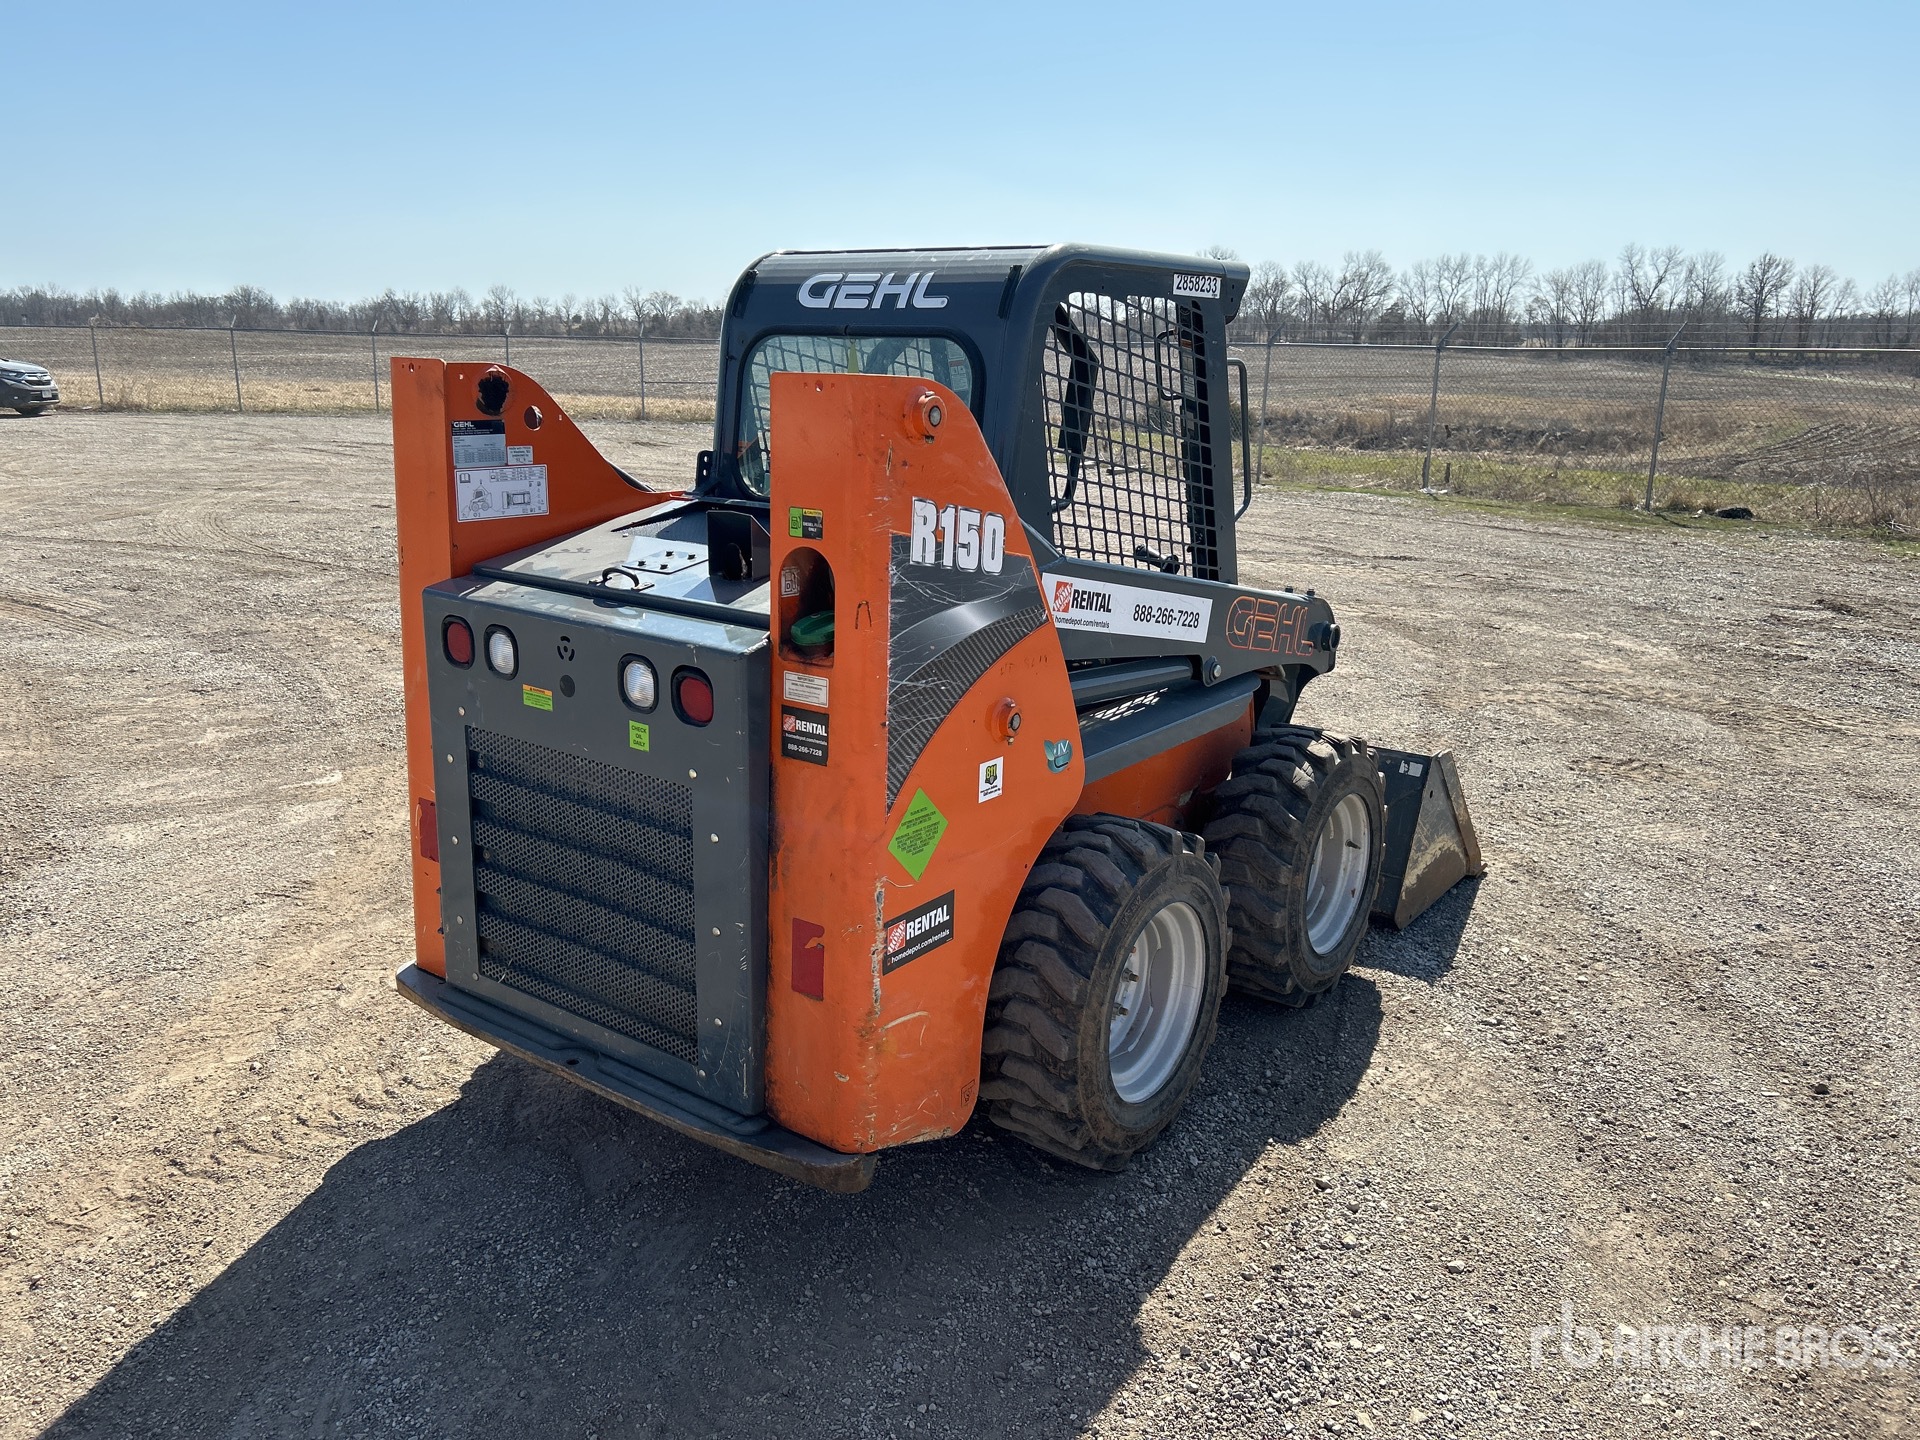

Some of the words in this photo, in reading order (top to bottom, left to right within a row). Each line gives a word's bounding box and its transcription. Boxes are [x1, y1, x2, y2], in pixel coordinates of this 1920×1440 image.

[797, 271, 949, 310] GEHL
[1176, 275, 1218, 294] 2858233
[910, 497, 1006, 575] R150
[1071, 589, 1112, 613] RENTAL
[1055, 616, 1110, 629] homedepot.com/rentals
[1133, 603, 1200, 629] 888-266-7228
[1226, 596, 1314, 656] GEHL
[631, 725, 647, 734] CHECK
[796, 720, 828, 736] RENTAL
[633, 739, 646, 747] DAILY
[788, 743, 823, 757] 888-266-7228
[986, 764, 998, 779] 811
[906, 904, 950, 940] RENTAL
[891, 929, 950, 964] homedepot.com/rentals
